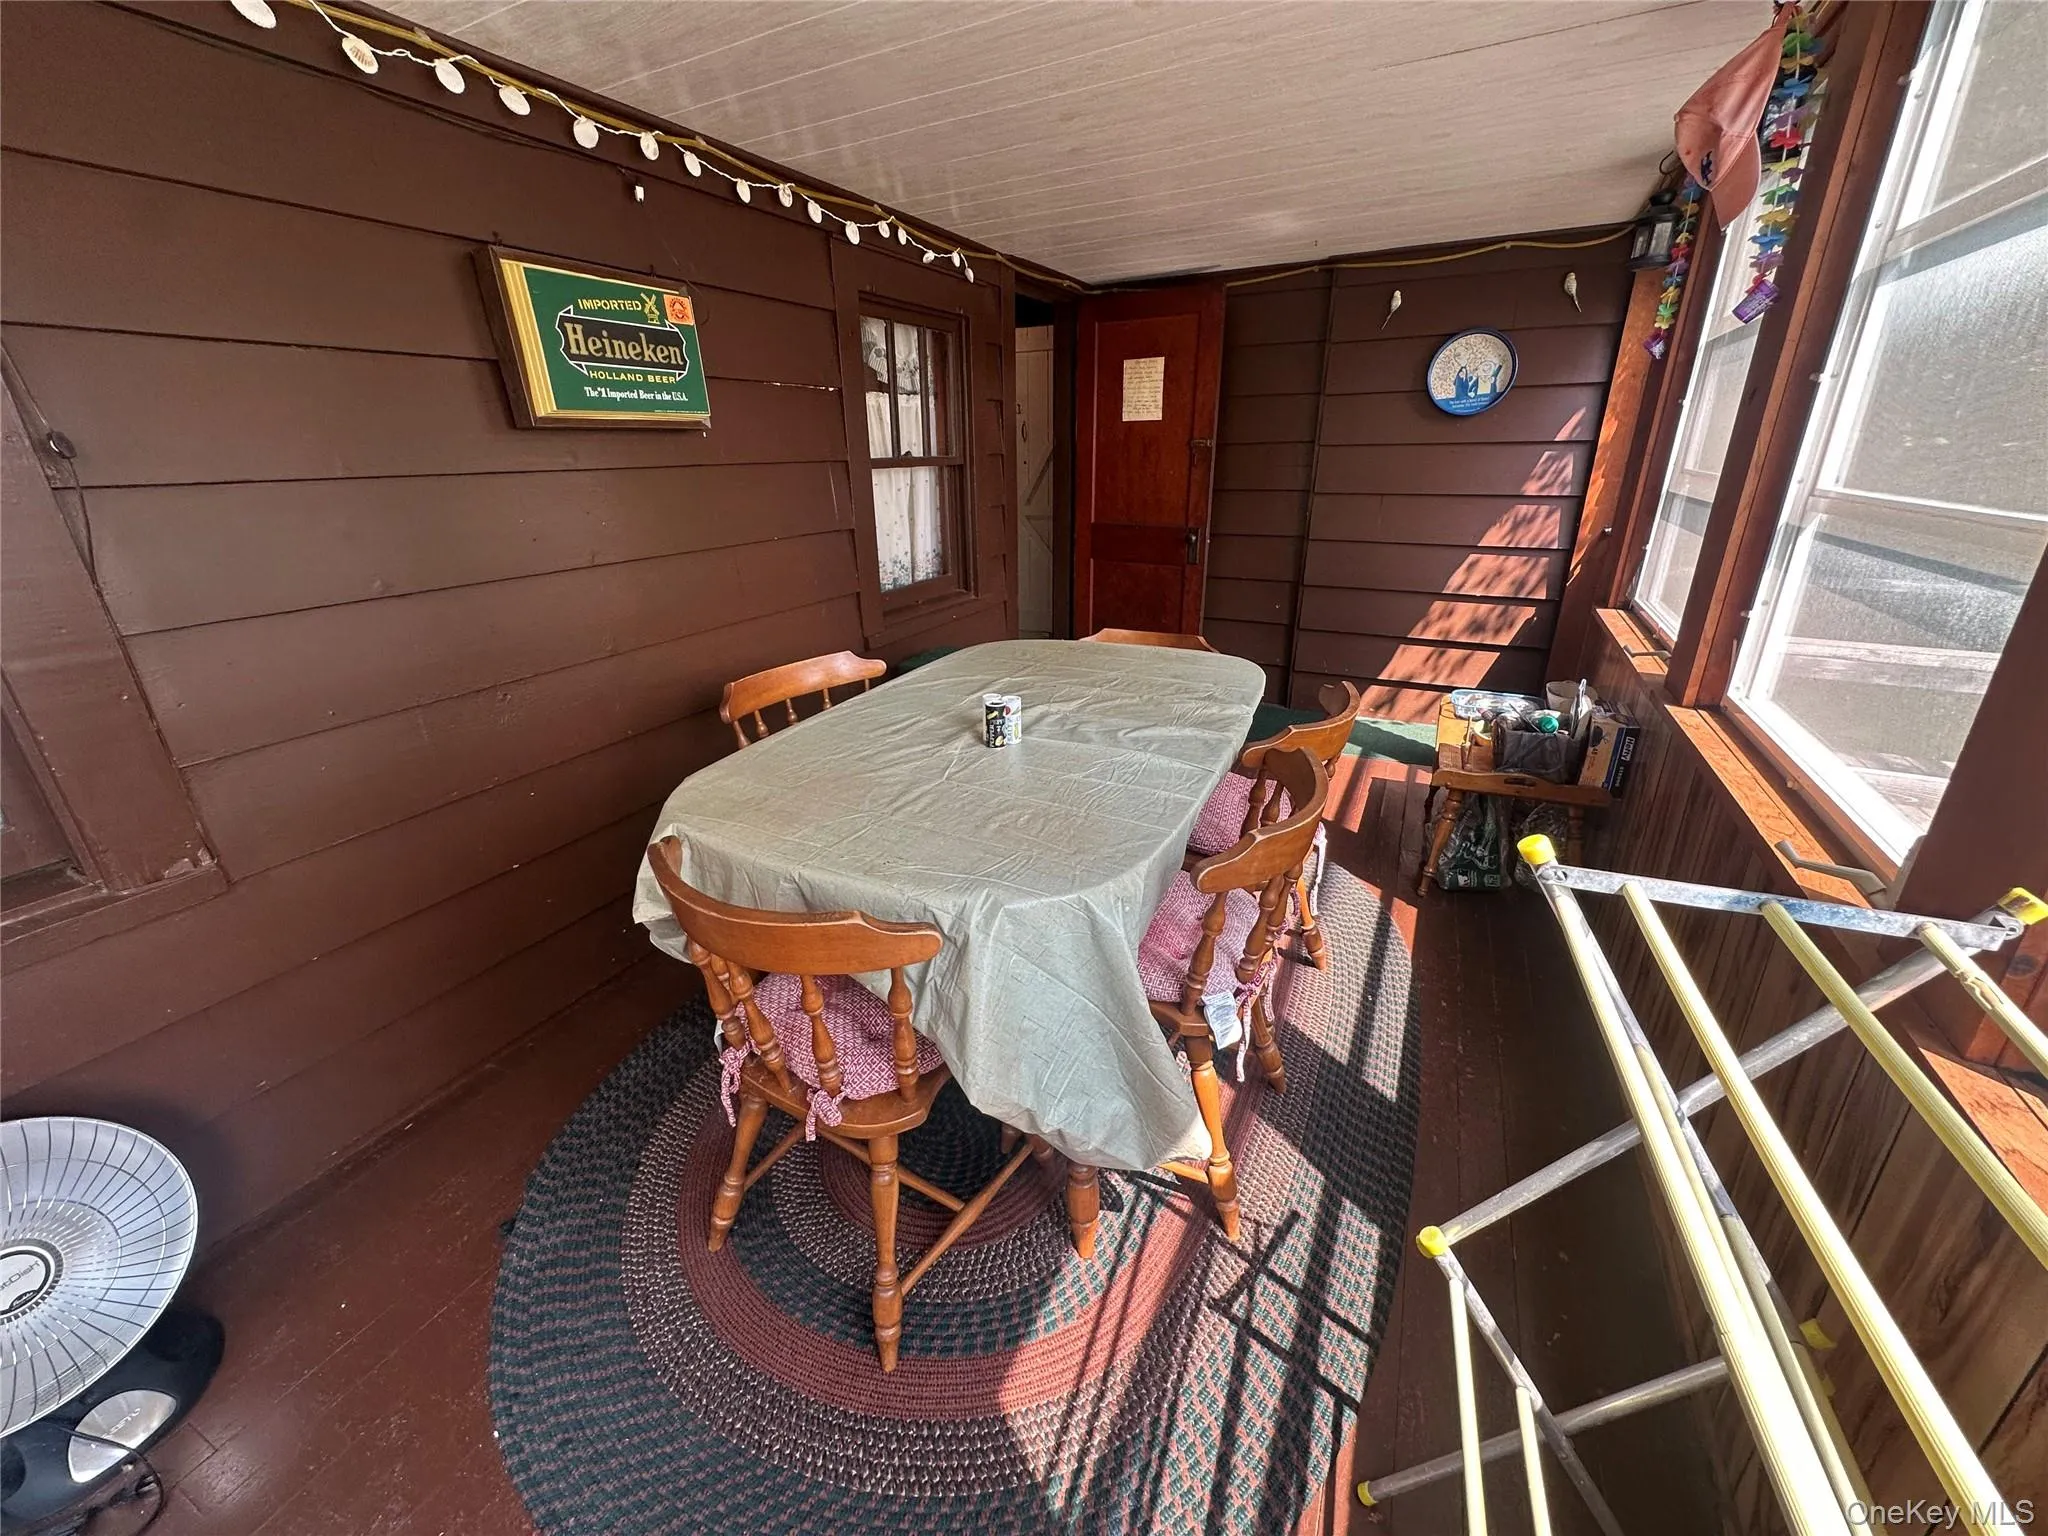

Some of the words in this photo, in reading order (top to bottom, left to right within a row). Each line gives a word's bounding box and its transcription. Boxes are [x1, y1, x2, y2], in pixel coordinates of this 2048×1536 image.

[578, 298, 642, 311] IMPORTED
[564, 322, 684, 365] Heineken
[589, 370, 644, 382] HOLLAND
[647, 374, 676, 384] BEER
[584, 386, 599, 397] The
[607, 388, 638, 401] Imported
[639, 390, 654, 400] Beer
[655, 391, 661, 400] in
[662, 391, 672, 400] the
[1621, 736, 1636, 761] Hefty
